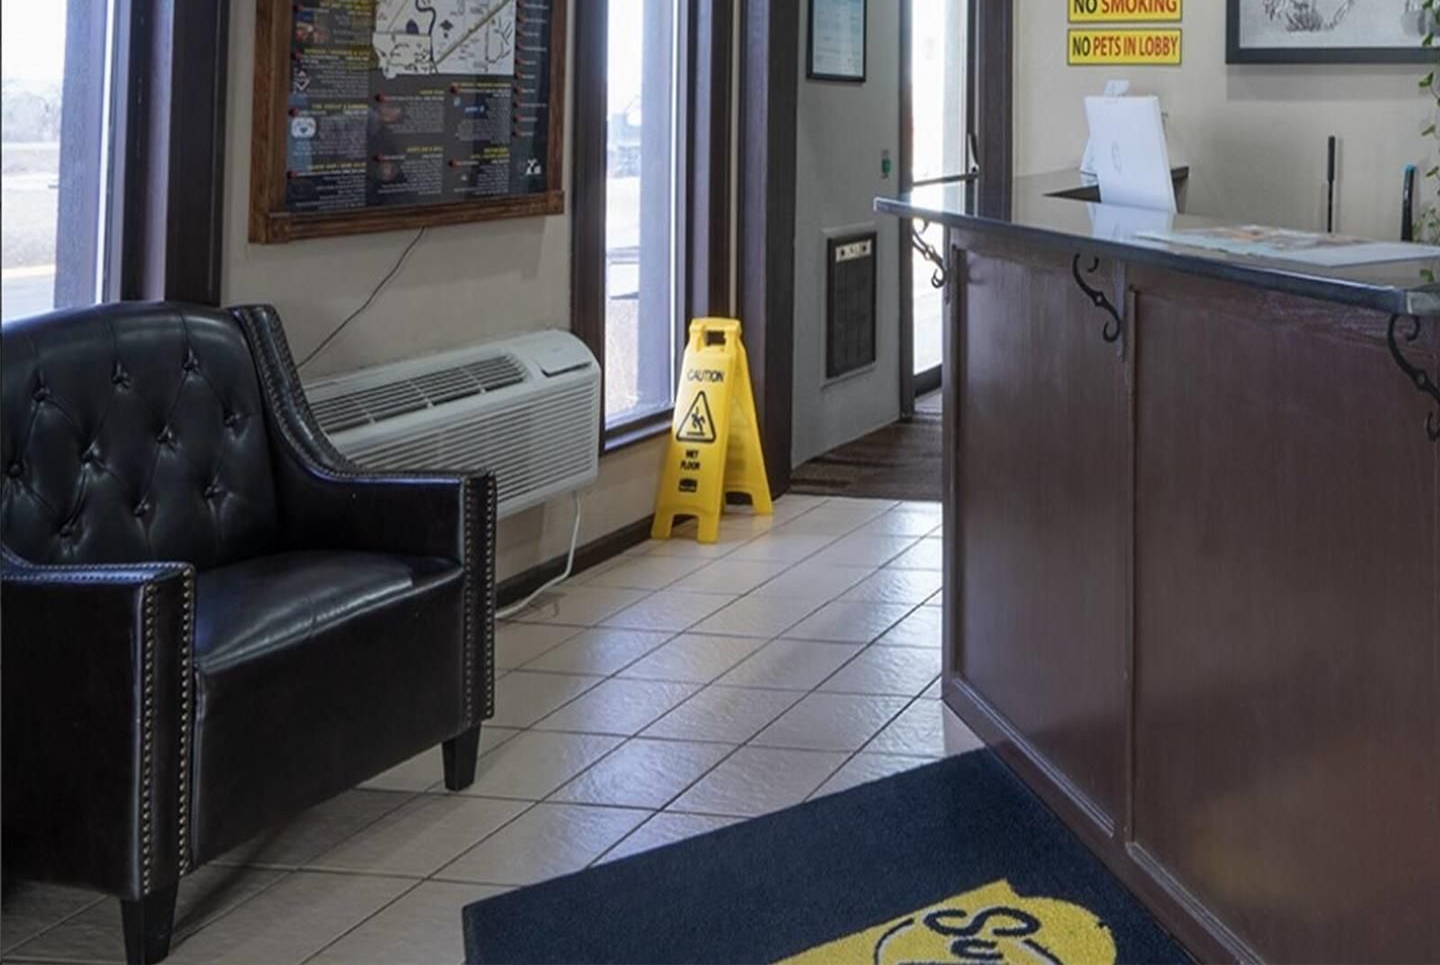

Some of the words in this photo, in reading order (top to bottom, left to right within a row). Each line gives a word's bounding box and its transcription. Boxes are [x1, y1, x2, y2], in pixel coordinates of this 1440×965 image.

[1072, 36, 1091, 56] NO
[1093, 36, 1121, 56] PETS
[1124, 36, 1137, 56] IN
[1139, 35, 1178, 56] LOBBY
[687, 368, 725, 382] CAUTION
[685, 449, 699, 459] WET
[680, 460, 701, 471] FLOOR
